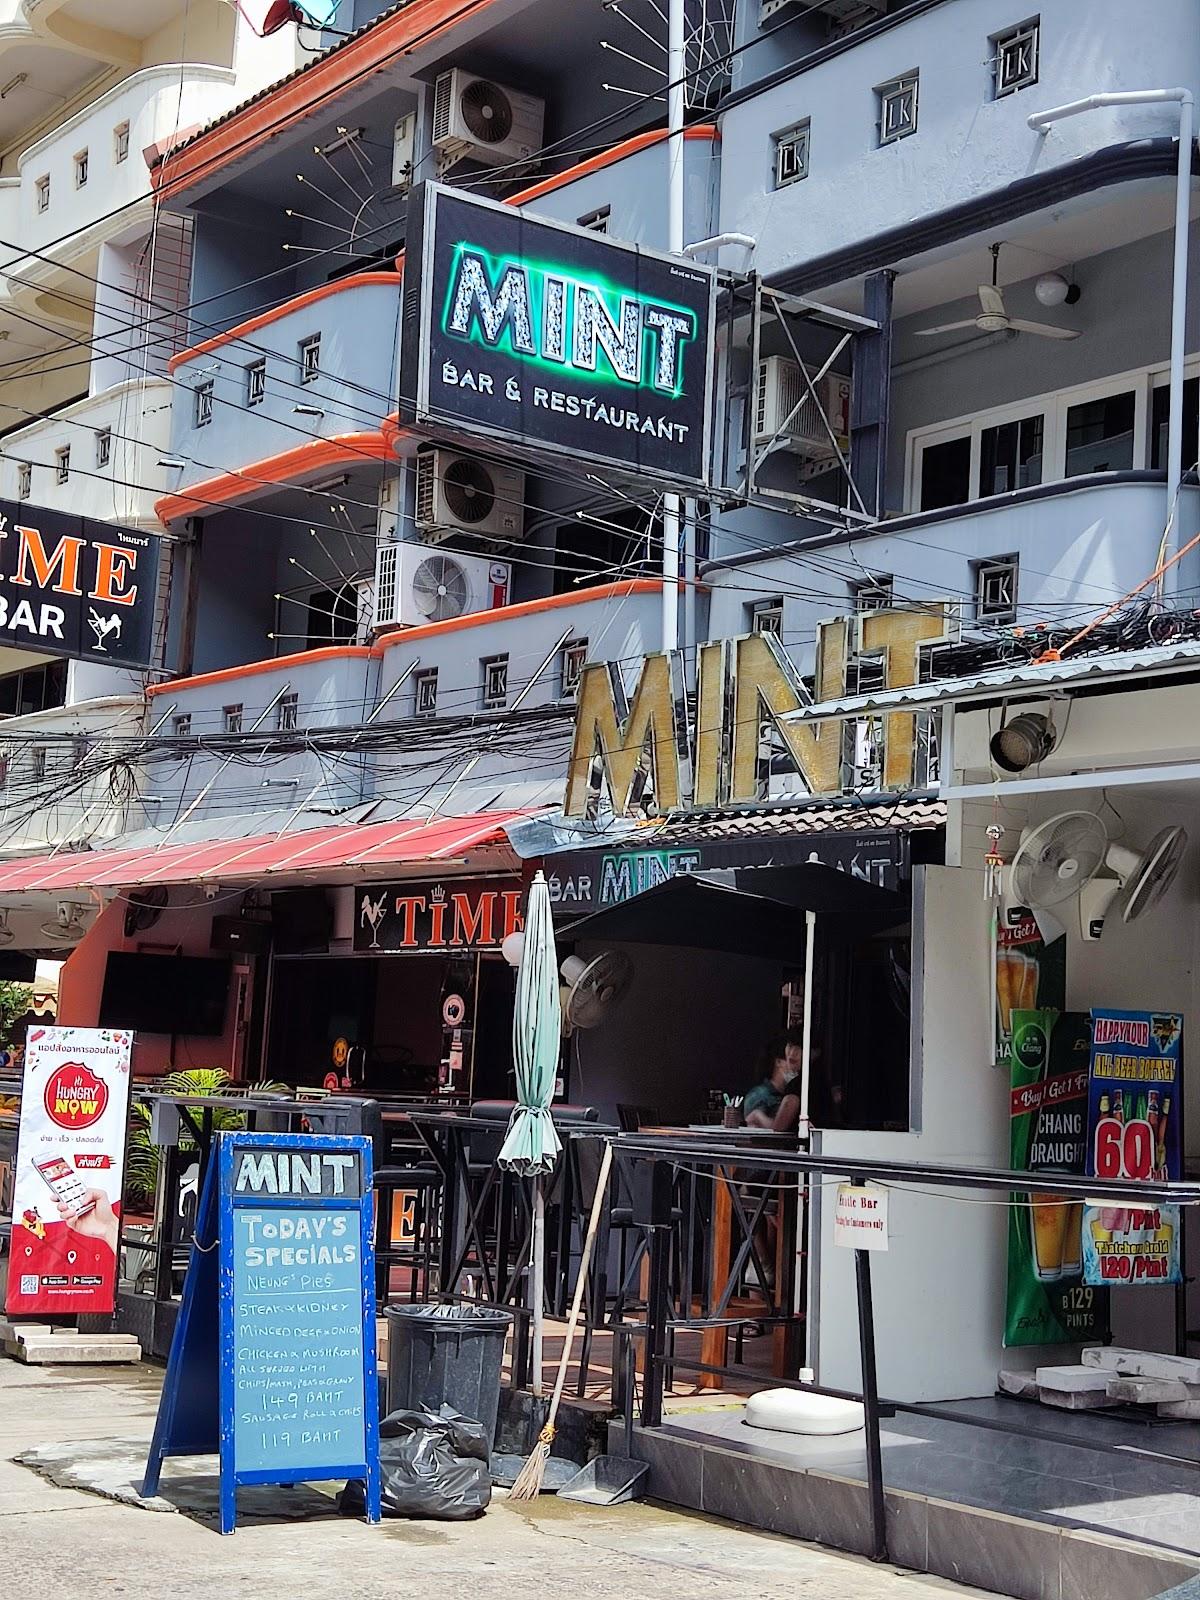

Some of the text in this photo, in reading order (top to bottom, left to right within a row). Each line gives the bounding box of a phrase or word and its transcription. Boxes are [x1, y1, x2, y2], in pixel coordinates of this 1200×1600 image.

[448, 253, 692, 393] MINT
[442, 359, 689, 444] BAR & RESTAURANT
[0, 525, 137, 606] ME
[563, 602, 952, 817] MINT
[549, 871, 592, 902] BAR
[1093, 1052, 1113, 1079] ALL
[1114, 1054, 1137, 1081] BEER
[56, 1077, 100, 1100] HUNGRY
[1021, 1089, 1042, 1107] Buy
[1049, 1081, 1066, 1098] Get
[54, 1099, 99, 1120] NOW
[1038, 1113, 1082, 1135] CHANG
[1094, 1117, 1155, 1179] 60
[235, 1153, 354, 1195] MINT
[861, 1197, 878, 1209] Bar
[240, 1303, 283, 1317] STEAK
[1066, 1313, 1095, 1327] PINTS
[238, 1347, 288, 1360] CHICKEN
[262, 1391, 344, 1411] 149 BAHT
[261, 1429, 342, 1449] 119 BAHT
